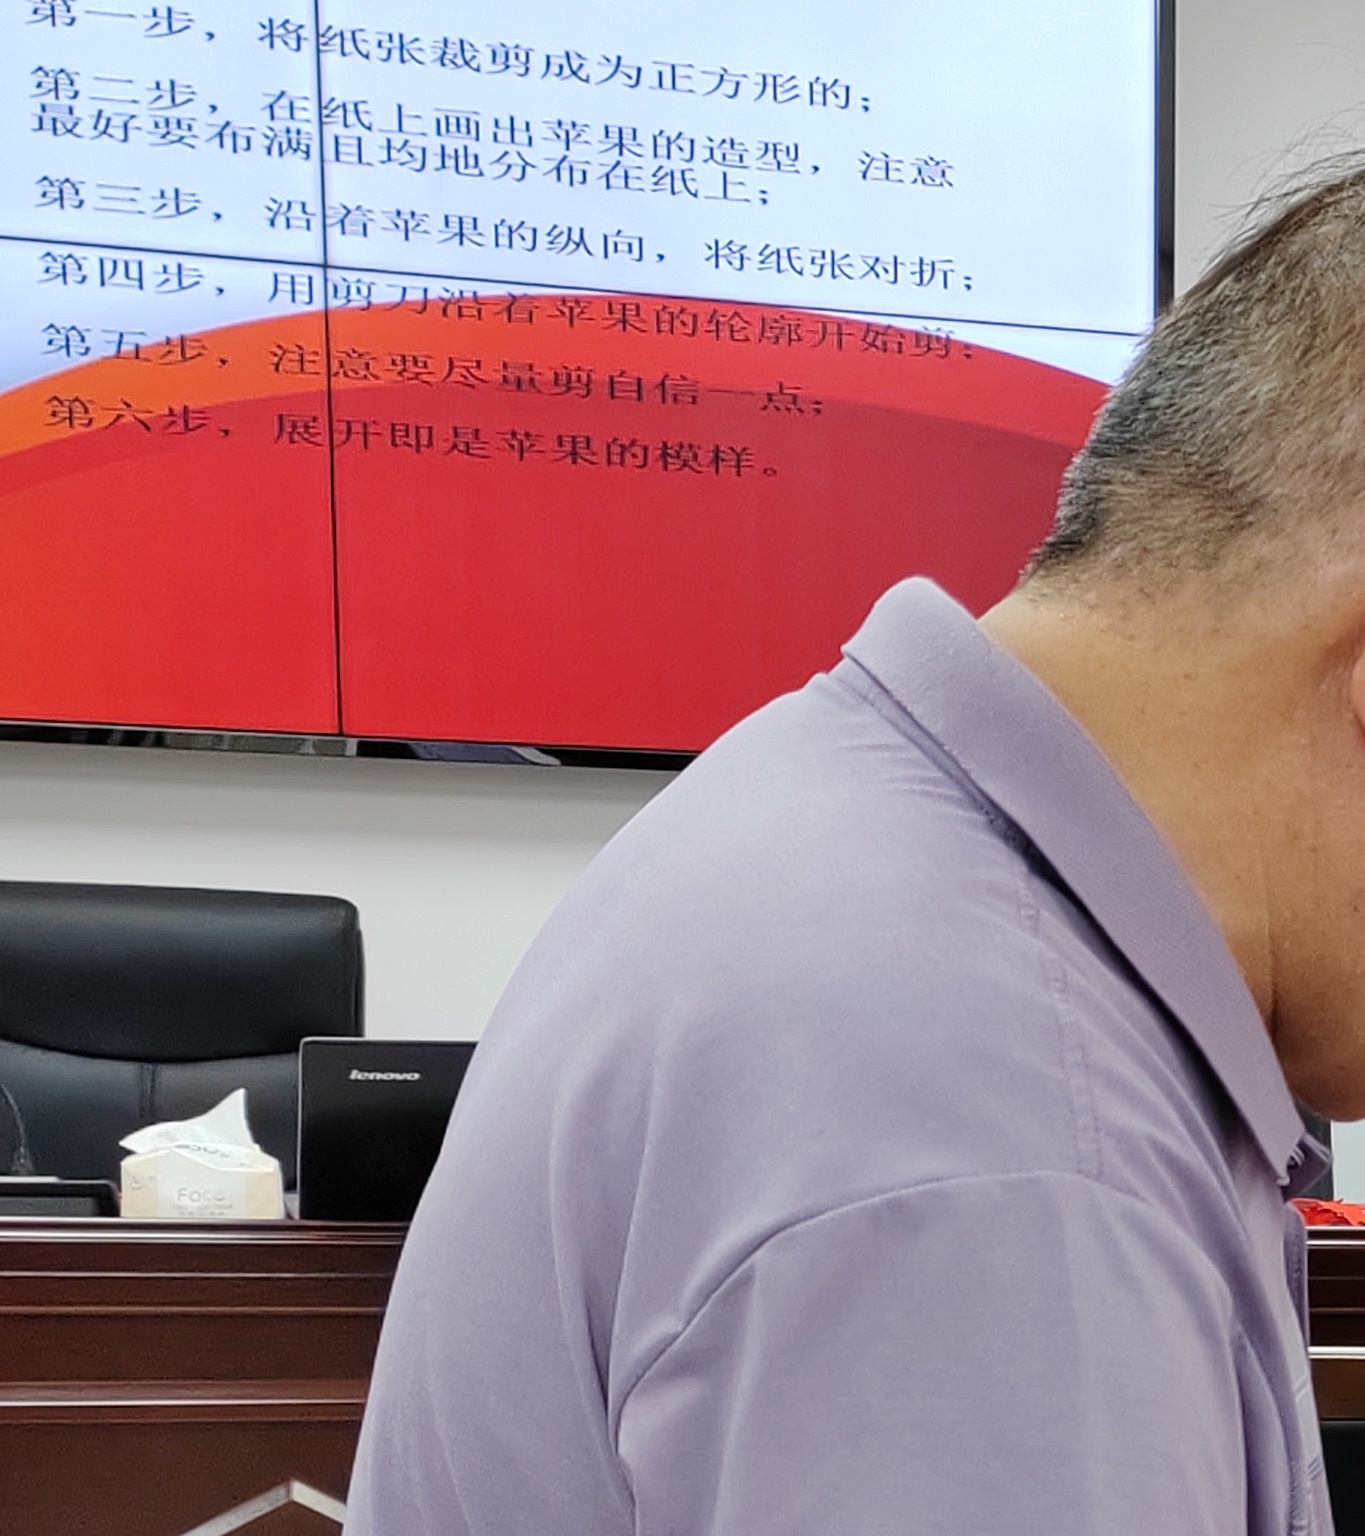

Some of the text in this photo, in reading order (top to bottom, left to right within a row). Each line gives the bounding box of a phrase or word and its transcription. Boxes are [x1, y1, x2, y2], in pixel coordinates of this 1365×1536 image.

[30, 66, 955, 190] 第二步，在纸上画出苹果的造型，注意
[35, 175, 974, 292] 第三步，沿着苹果的纵向，将纸张对折；
[349, 1069, 421, 1081] lenovo
